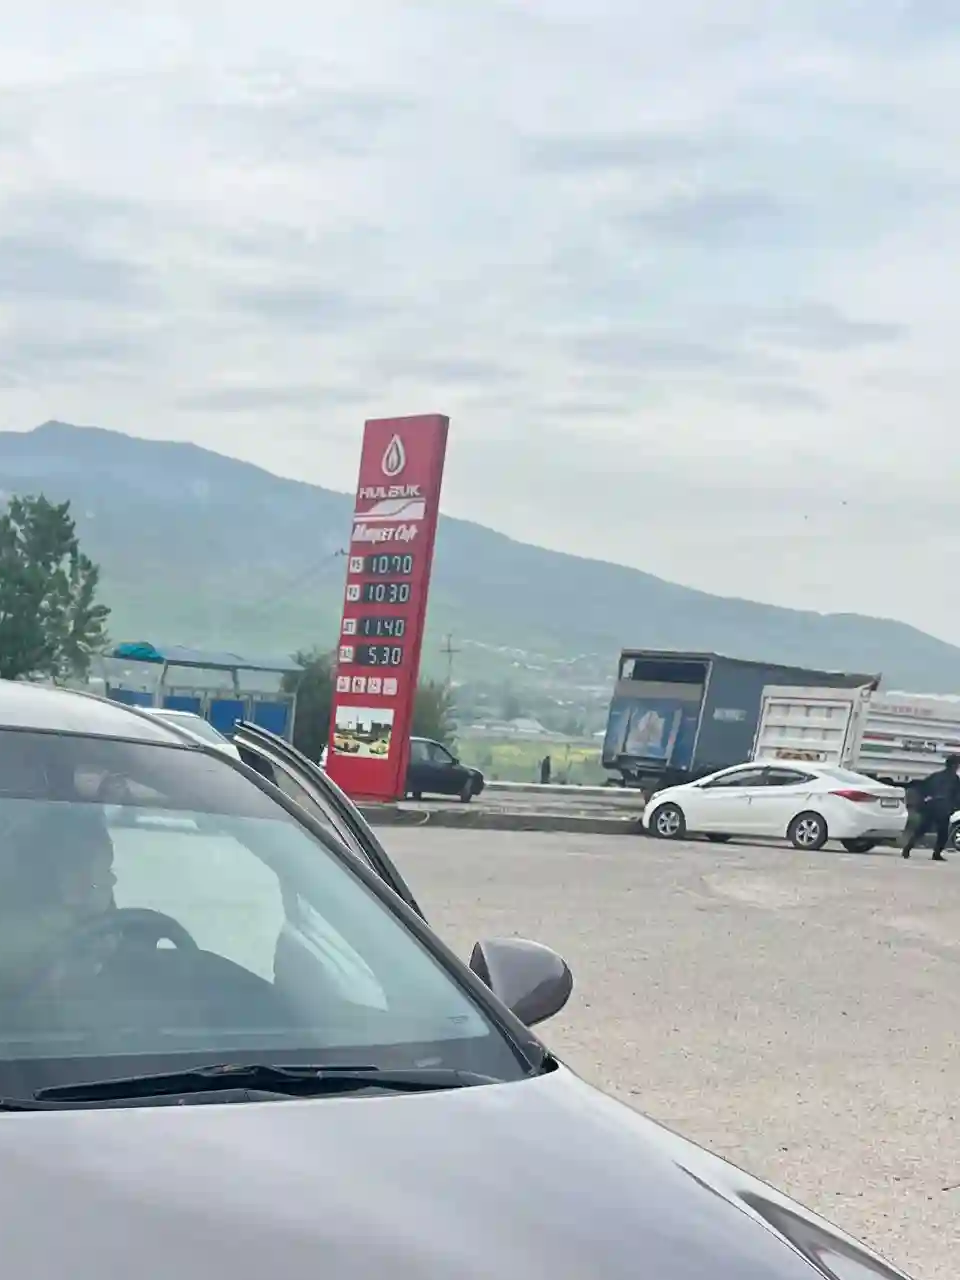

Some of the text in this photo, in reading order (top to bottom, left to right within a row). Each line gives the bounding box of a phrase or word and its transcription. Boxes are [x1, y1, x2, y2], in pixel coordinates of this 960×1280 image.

[359, 484, 421, 499] HULBUK
[372, 555, 413, 574] 10.70
[364, 619, 405, 637] 11.40
[368, 647, 402, 665] 5.30
